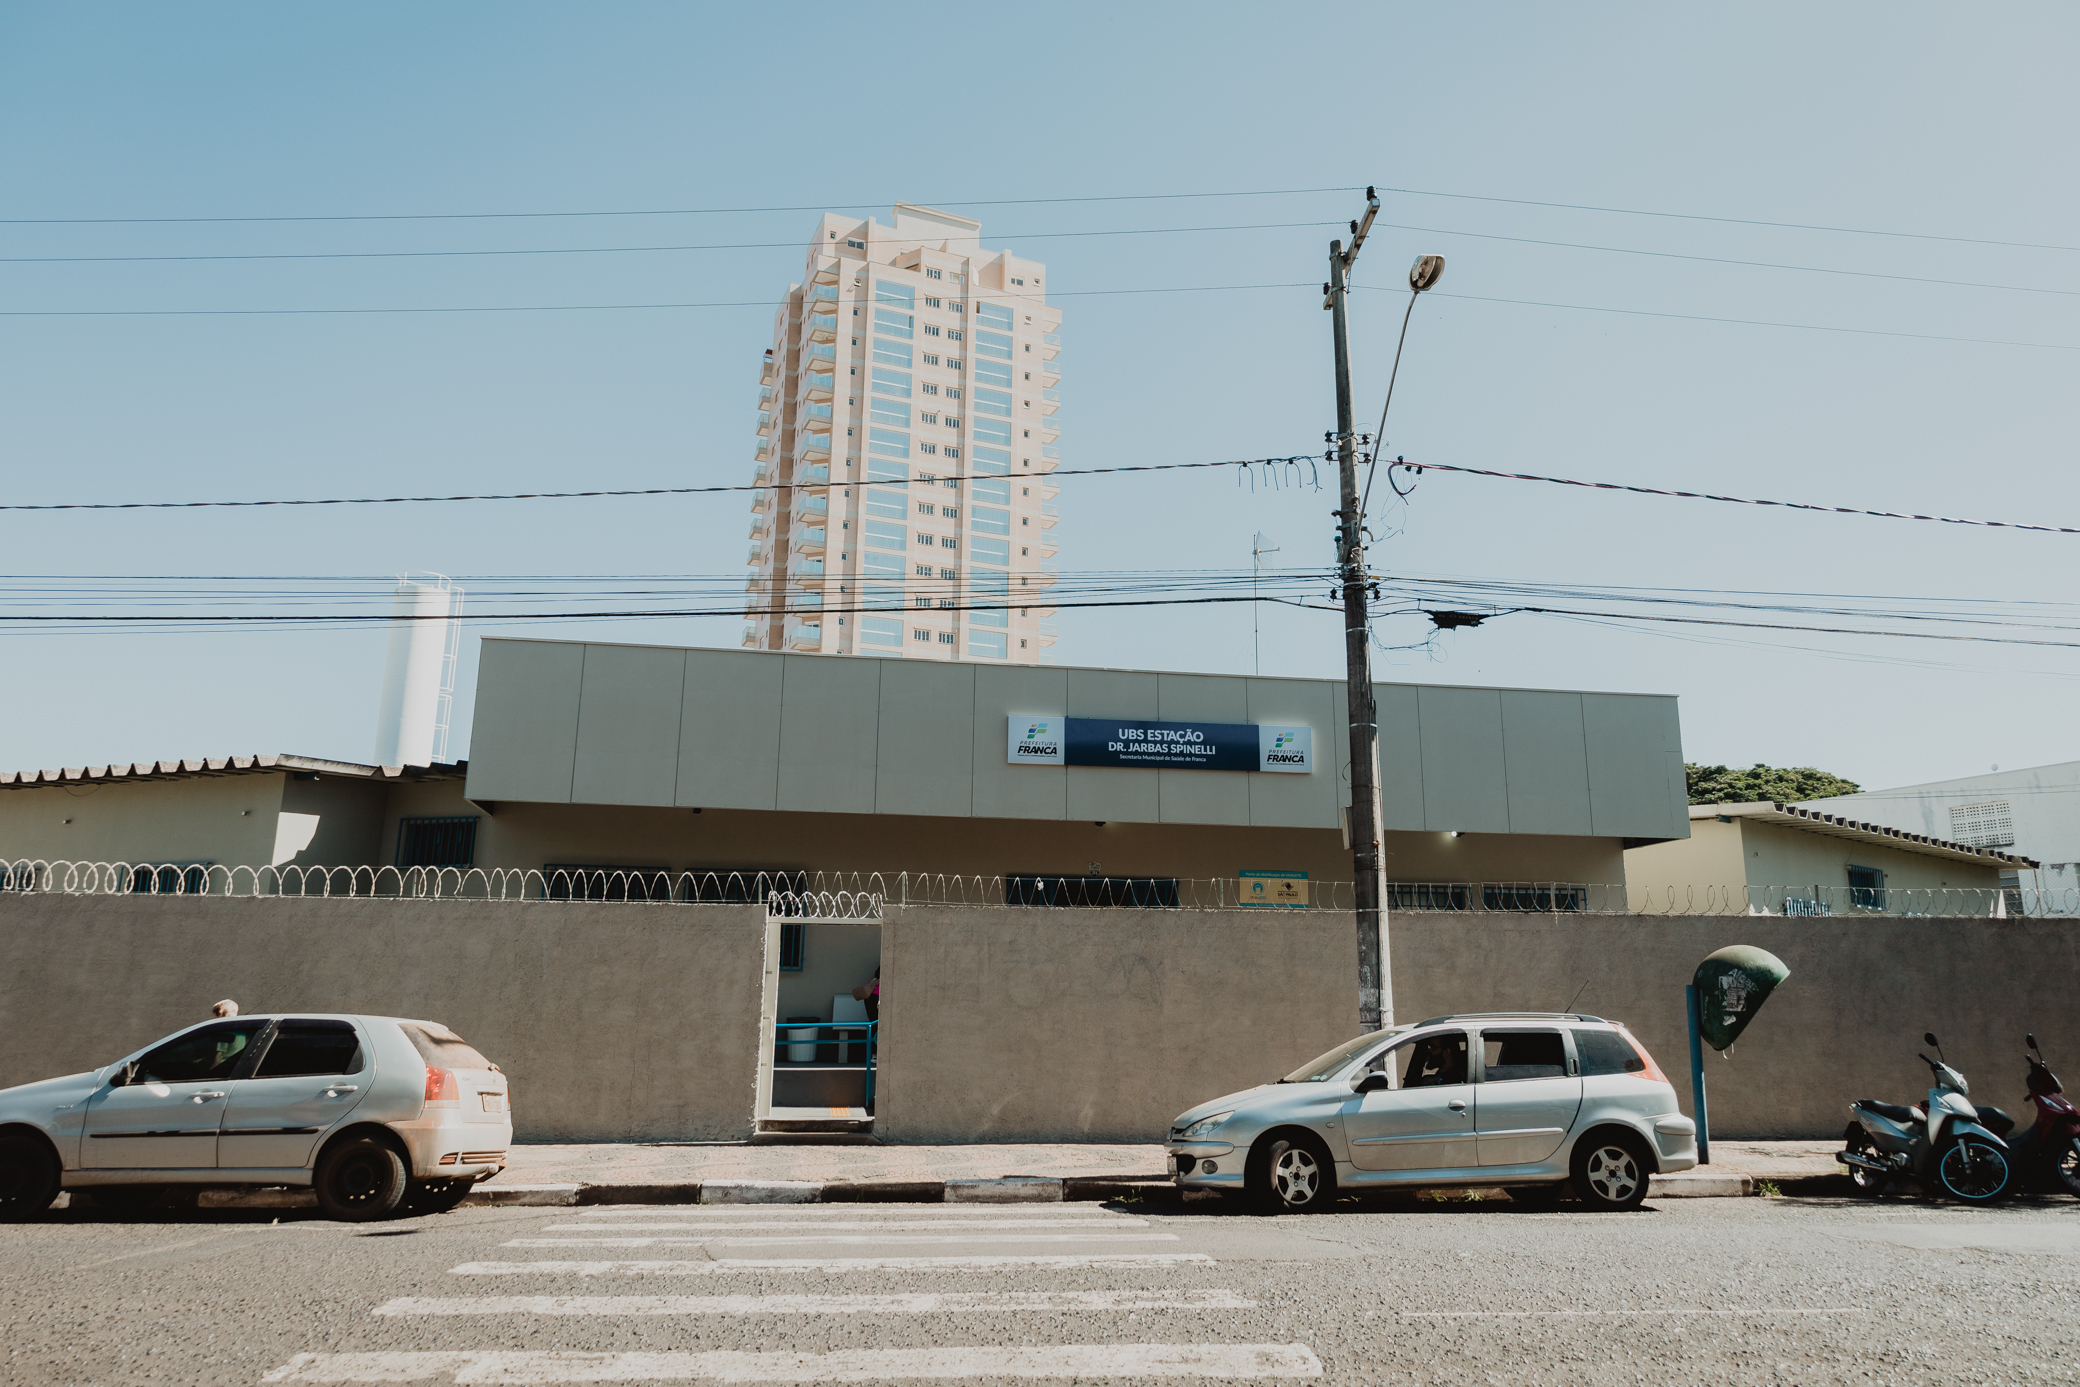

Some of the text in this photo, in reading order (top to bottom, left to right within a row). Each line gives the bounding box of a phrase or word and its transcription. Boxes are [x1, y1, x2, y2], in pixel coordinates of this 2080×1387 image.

[1118, 728, 1204, 744] UBS ESTAÇÃO
[1017, 745, 1058, 755] FRANCA
[1108, 741, 1216, 755] DR. JARBAS SPINELLI
[1267, 754, 1304, 763] FRANCA
